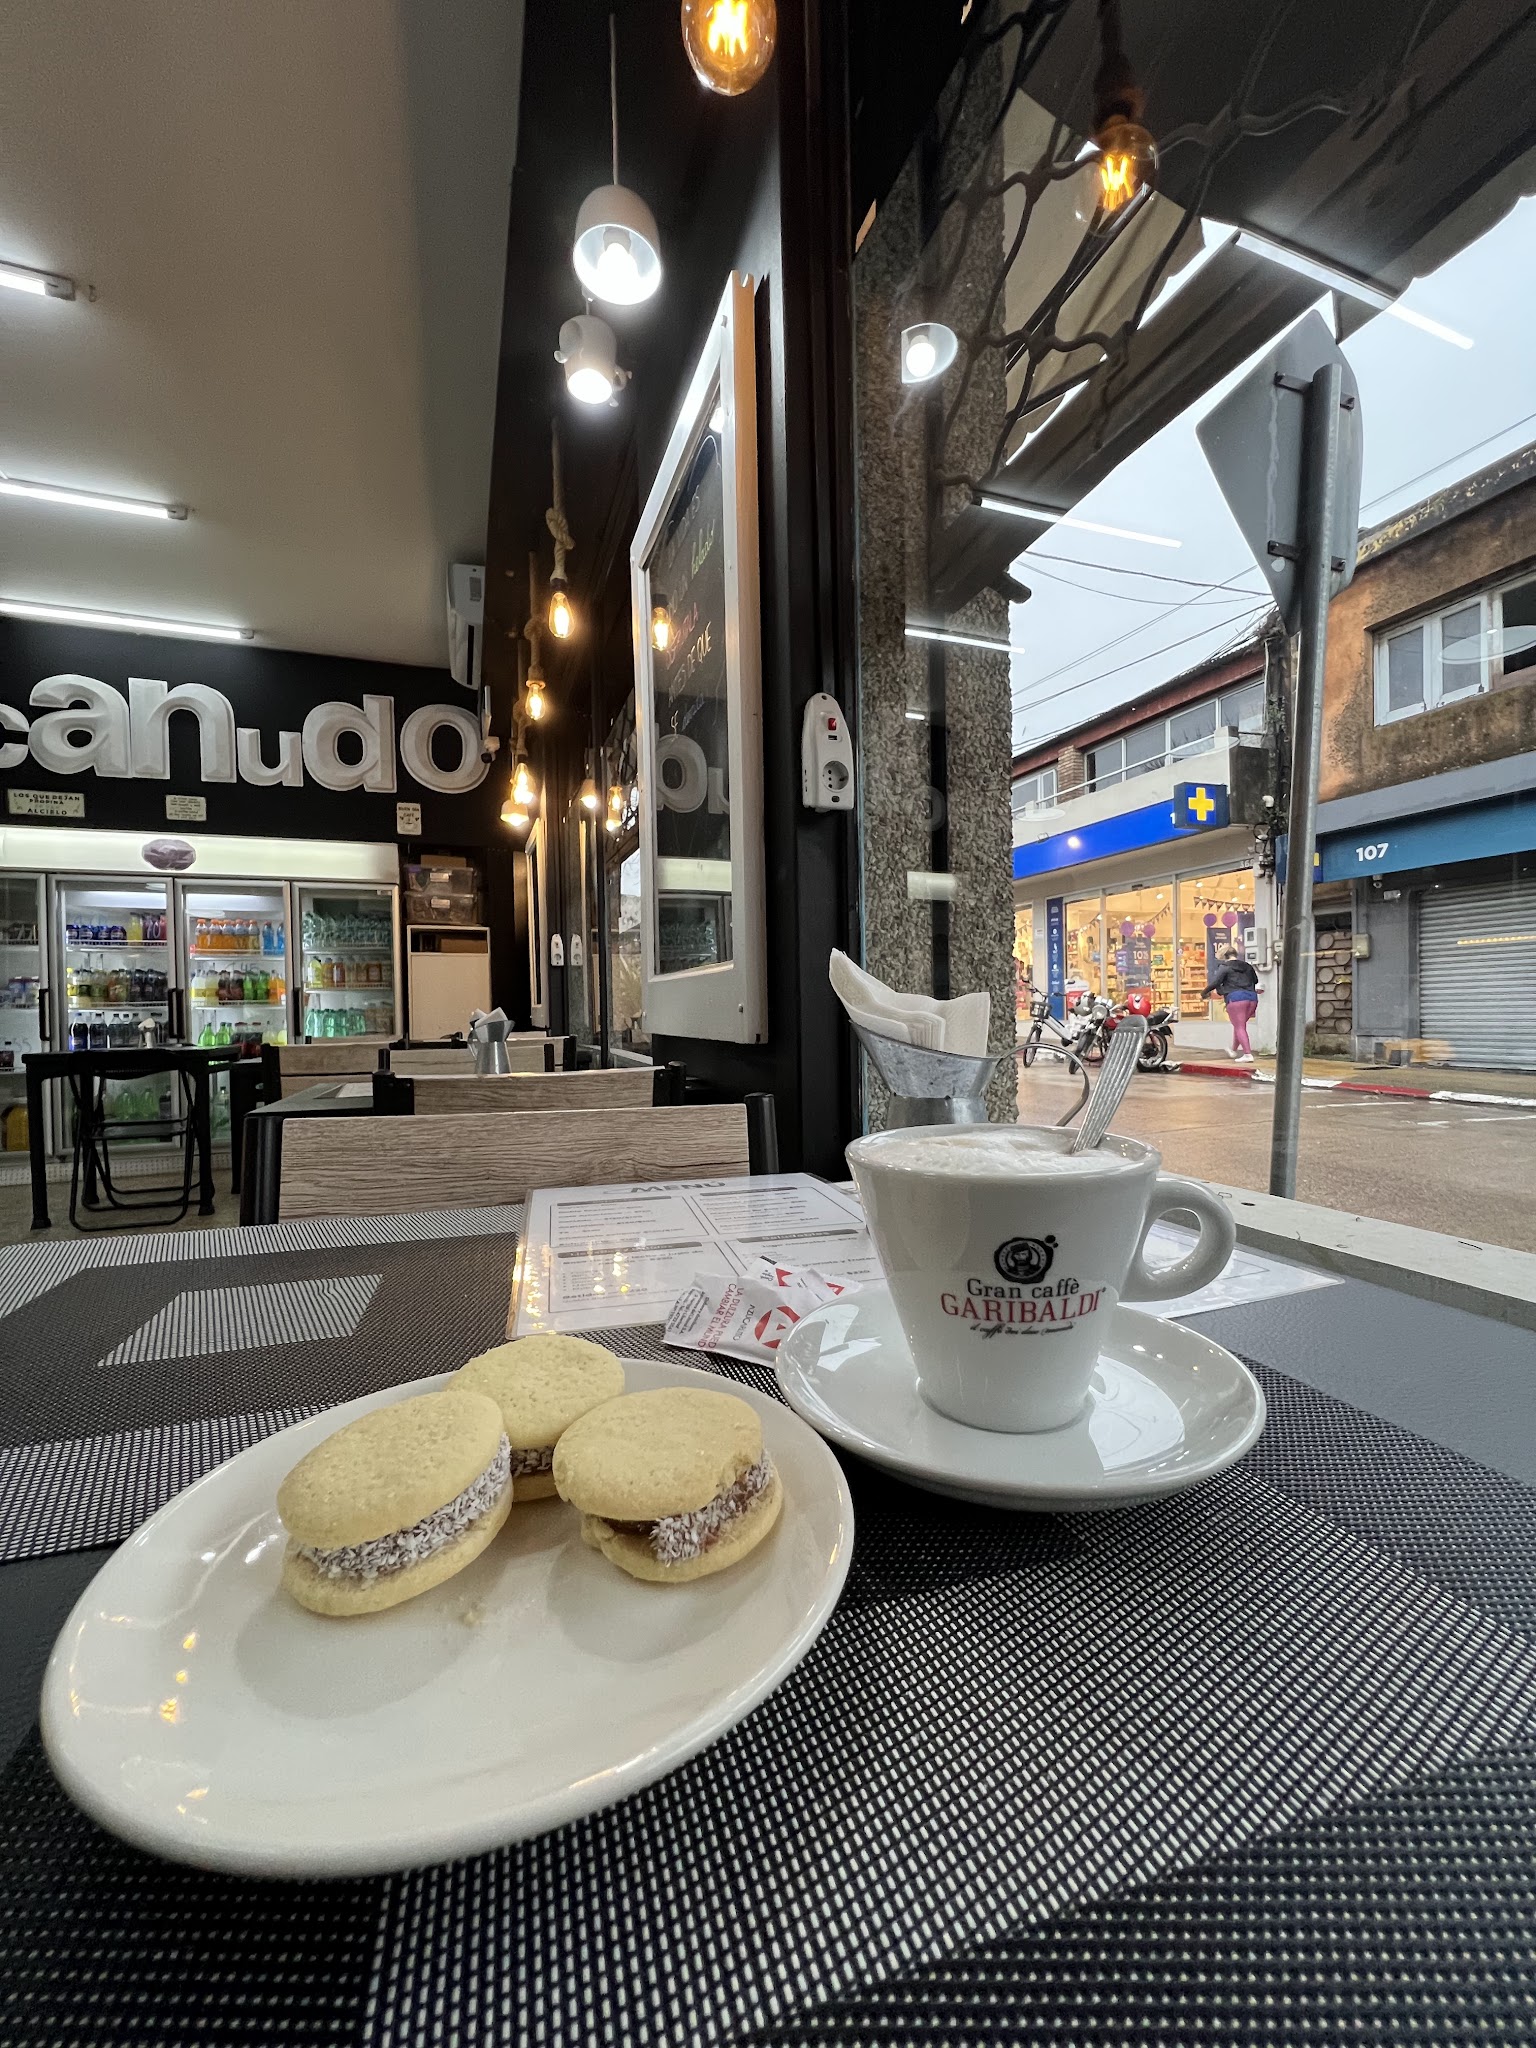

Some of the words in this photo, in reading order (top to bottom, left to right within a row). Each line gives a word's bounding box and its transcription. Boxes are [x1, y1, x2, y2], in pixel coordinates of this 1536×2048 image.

[696, 621, 712, 664] QUE
[1355, 842, 1389, 862] 107
[714, 1283, 737, 1316] CAMBIAR
[736, 1286, 745, 1297] LA
[967, 1278, 1022, 1299] Gran
[1031, 1277, 1080, 1299] caffè
[720, 1298, 741, 1329] DULZURA
[940, 1289, 1101, 1324] GARIBALDI
[711, 1316, 722, 1324] EL
